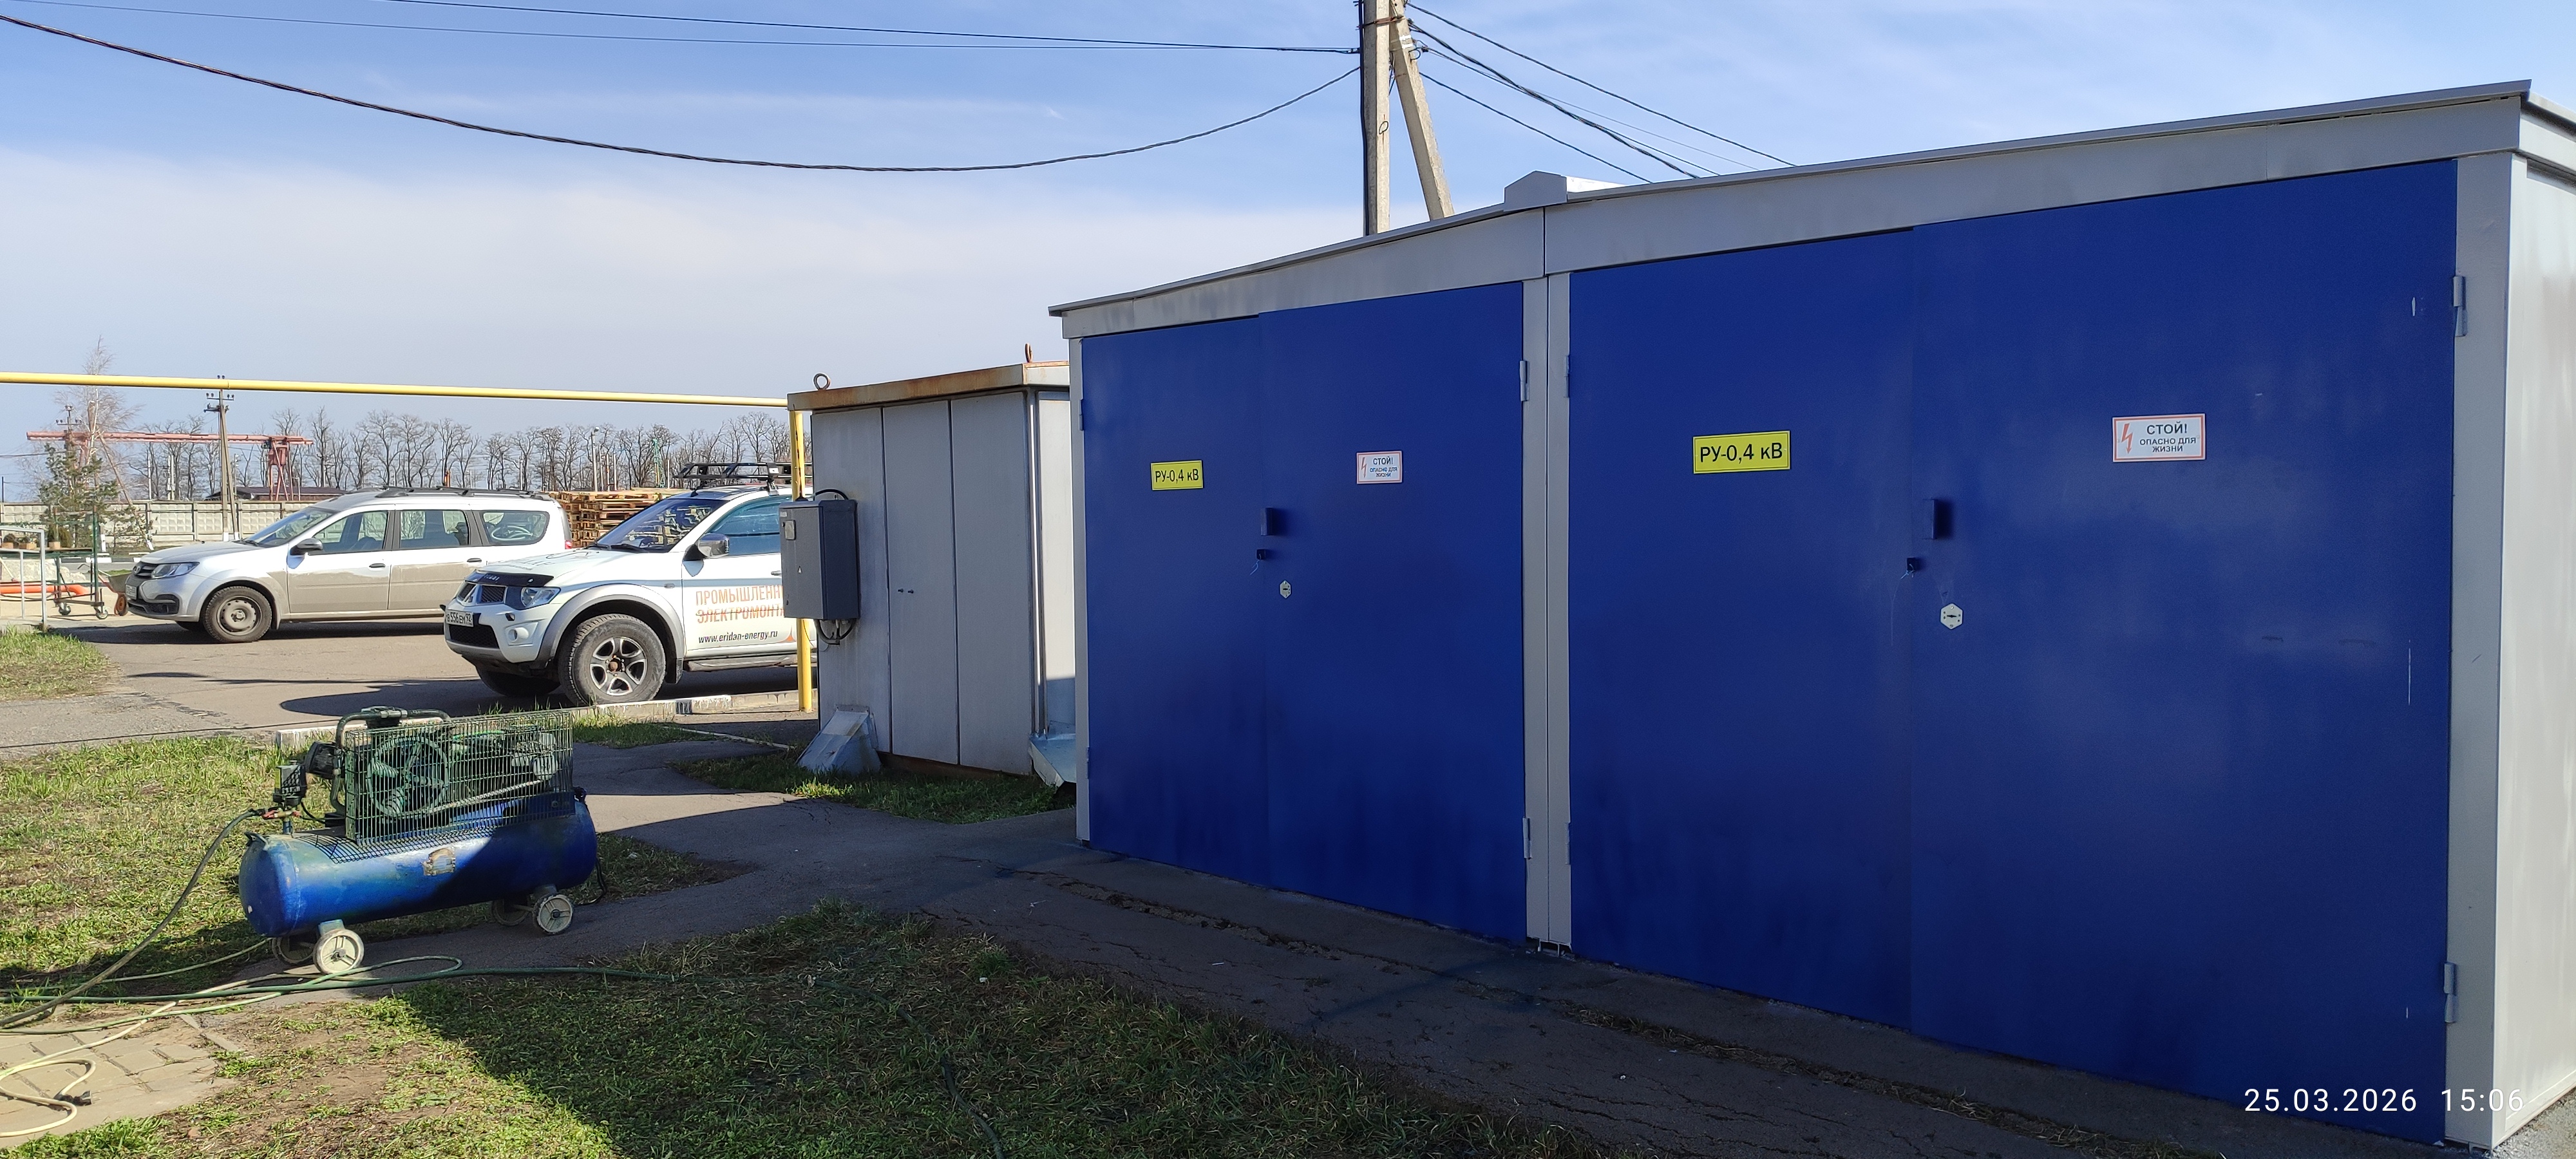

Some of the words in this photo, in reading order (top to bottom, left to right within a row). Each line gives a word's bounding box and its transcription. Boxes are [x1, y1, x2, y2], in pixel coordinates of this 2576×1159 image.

[2146, 420, 2187, 435] СТОЙ!
[2178, 437, 2196, 446] ДЛЯ
[1373, 456, 1393, 465] СТОЙ!
[1700, 443, 1754, 464] РУ-0,4
[1761, 442, 1783, 460] кВ
[1155, 469, 1184, 484] РУ-0,4
[1187, 468, 1198, 481] кВ
[696, 585, 783, 606] ПРОМЫШЛЕНН
[698, 630, 778, 644] www.eridan-energy.ru
